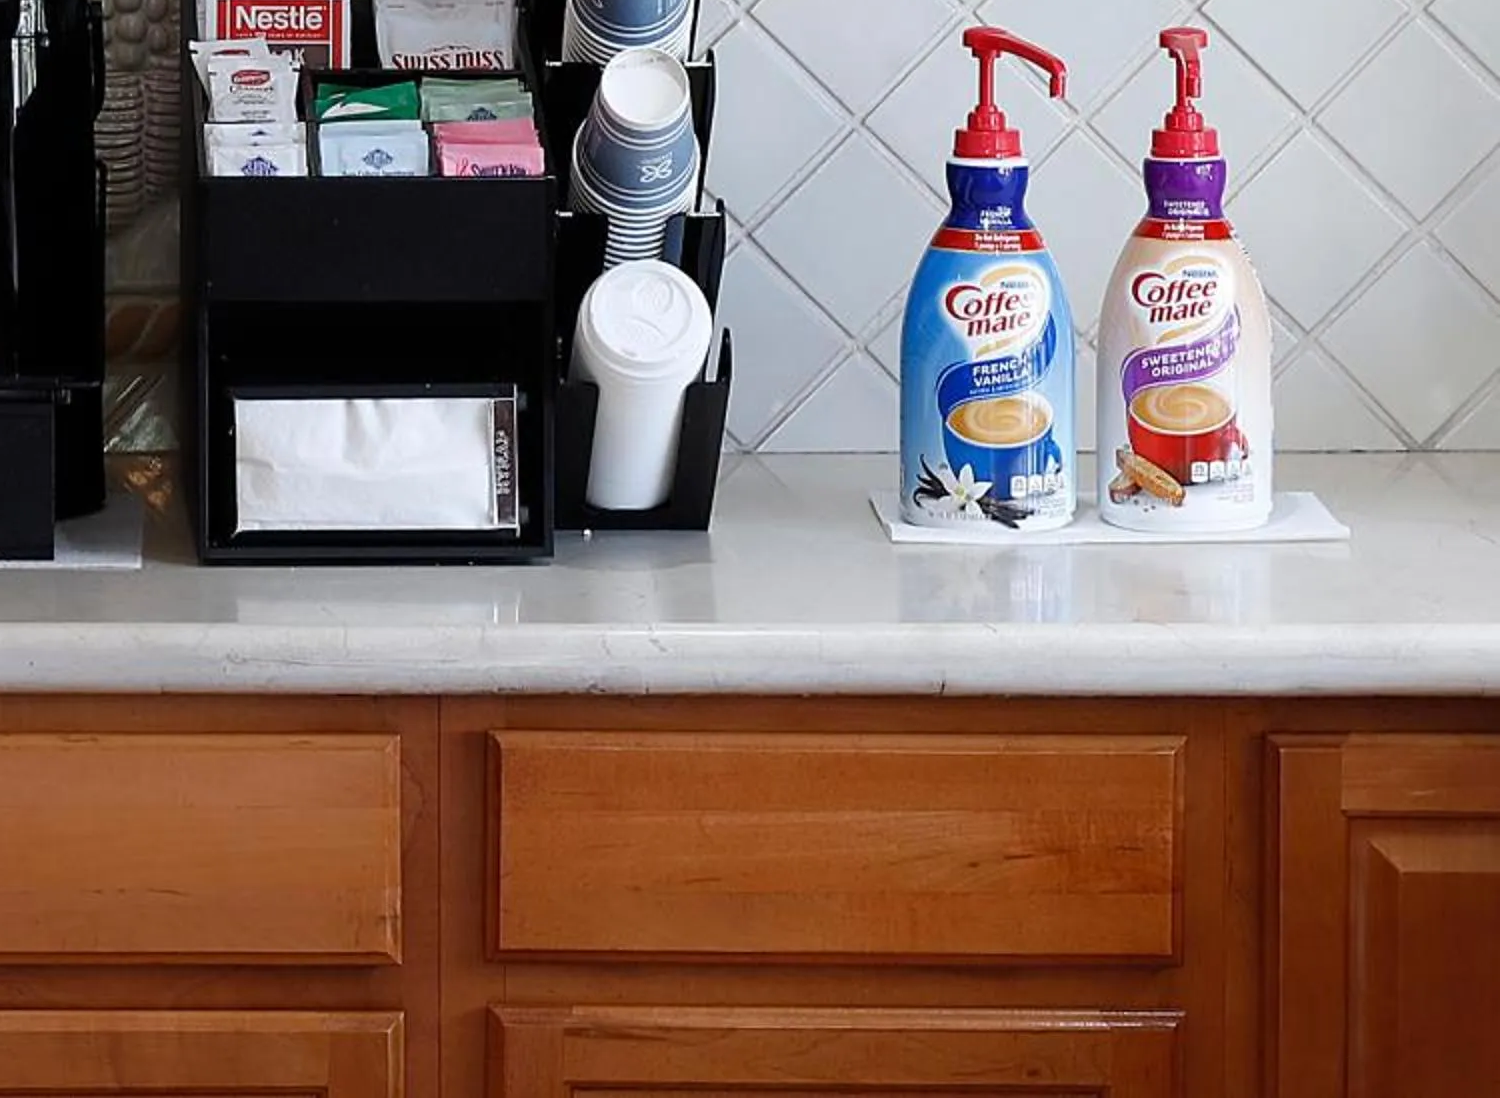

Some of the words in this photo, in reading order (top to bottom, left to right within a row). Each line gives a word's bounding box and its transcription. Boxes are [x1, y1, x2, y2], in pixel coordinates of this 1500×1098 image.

[1131, 271, 1218, 308] Coffee
[1150, 300, 1212, 323] mate
[967, 310, 1031, 337] mate
[973, 356, 1028, 377] FRENCH
[973, 368, 1030, 387] VANILLA
[1151, 357, 1214, 377] ORIGINAL
